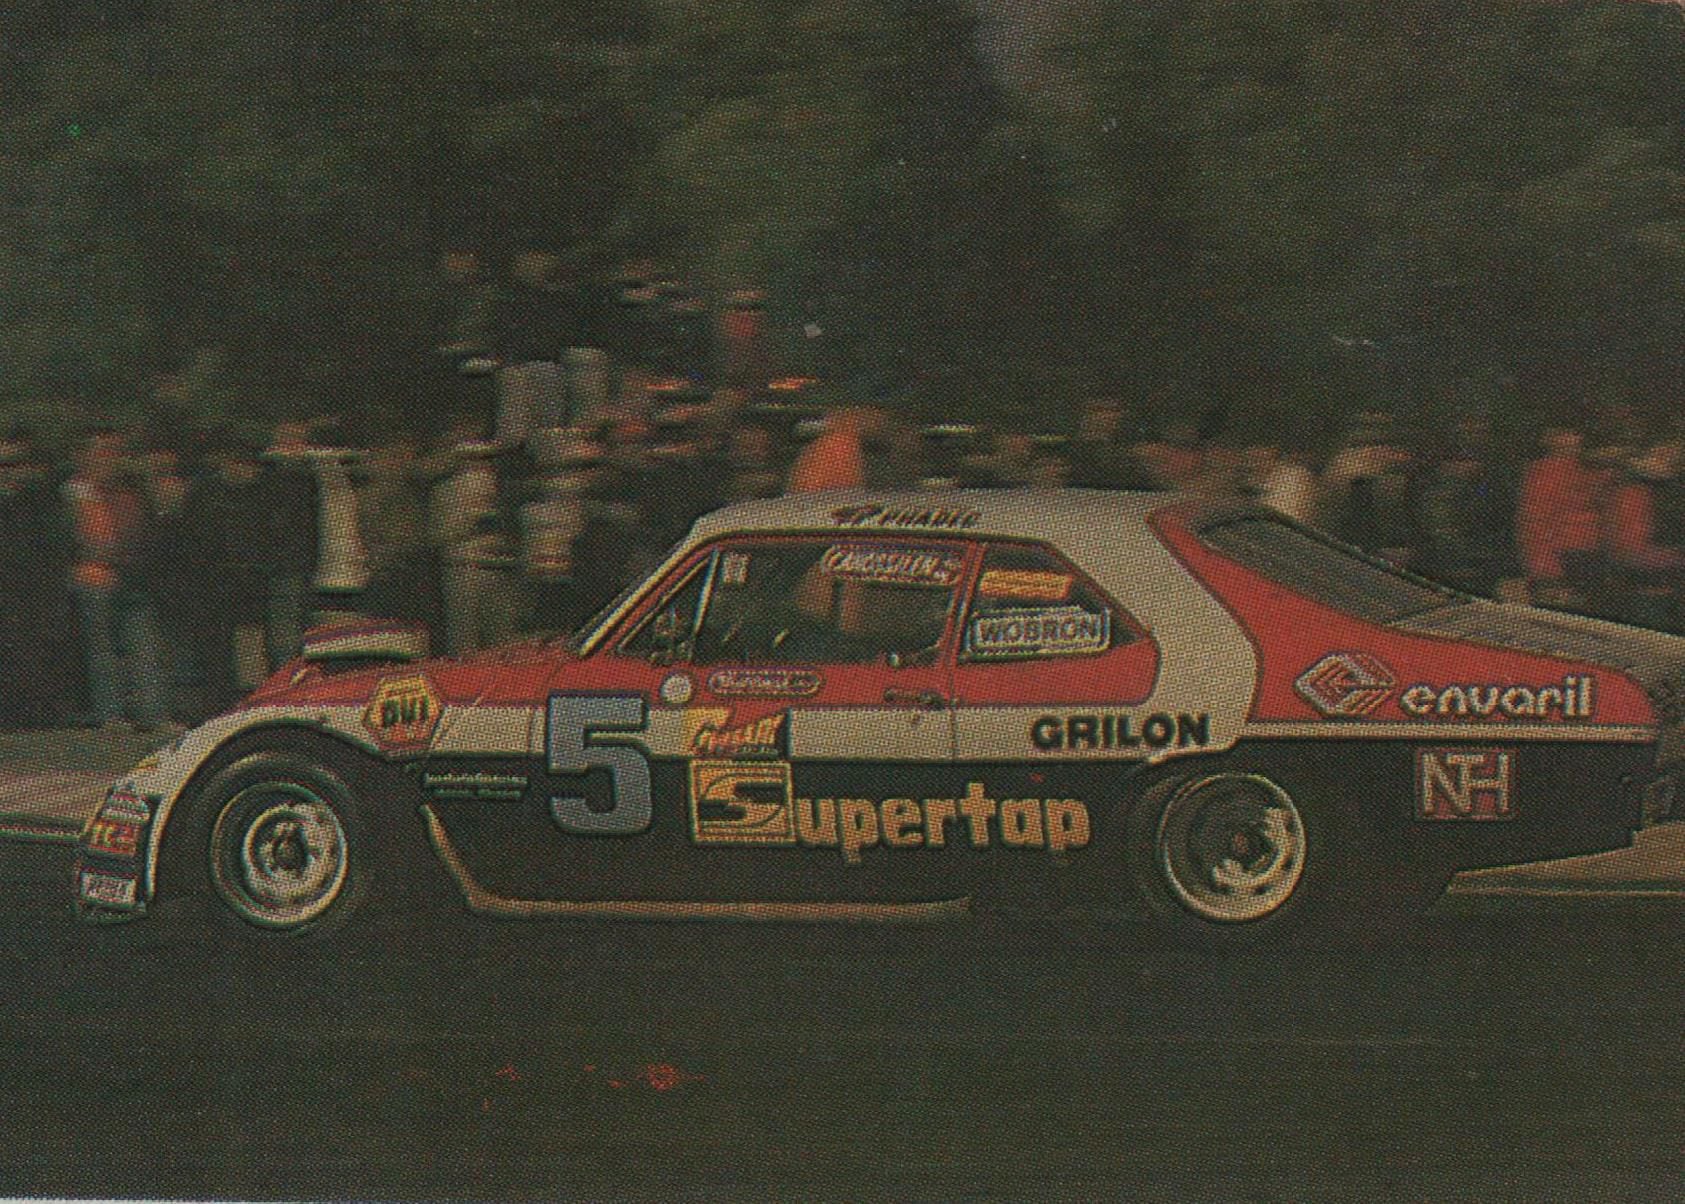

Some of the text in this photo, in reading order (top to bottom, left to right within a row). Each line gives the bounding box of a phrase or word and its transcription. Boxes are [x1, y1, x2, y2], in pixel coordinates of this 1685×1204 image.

[980, 616, 1096, 642] WOBRON
[1400, 675, 1594, 718] envaril
[1031, 713, 1210, 749] GRILON
[547, 693, 651, 834] 5
[689, 760, 1092, 864] Supertap
